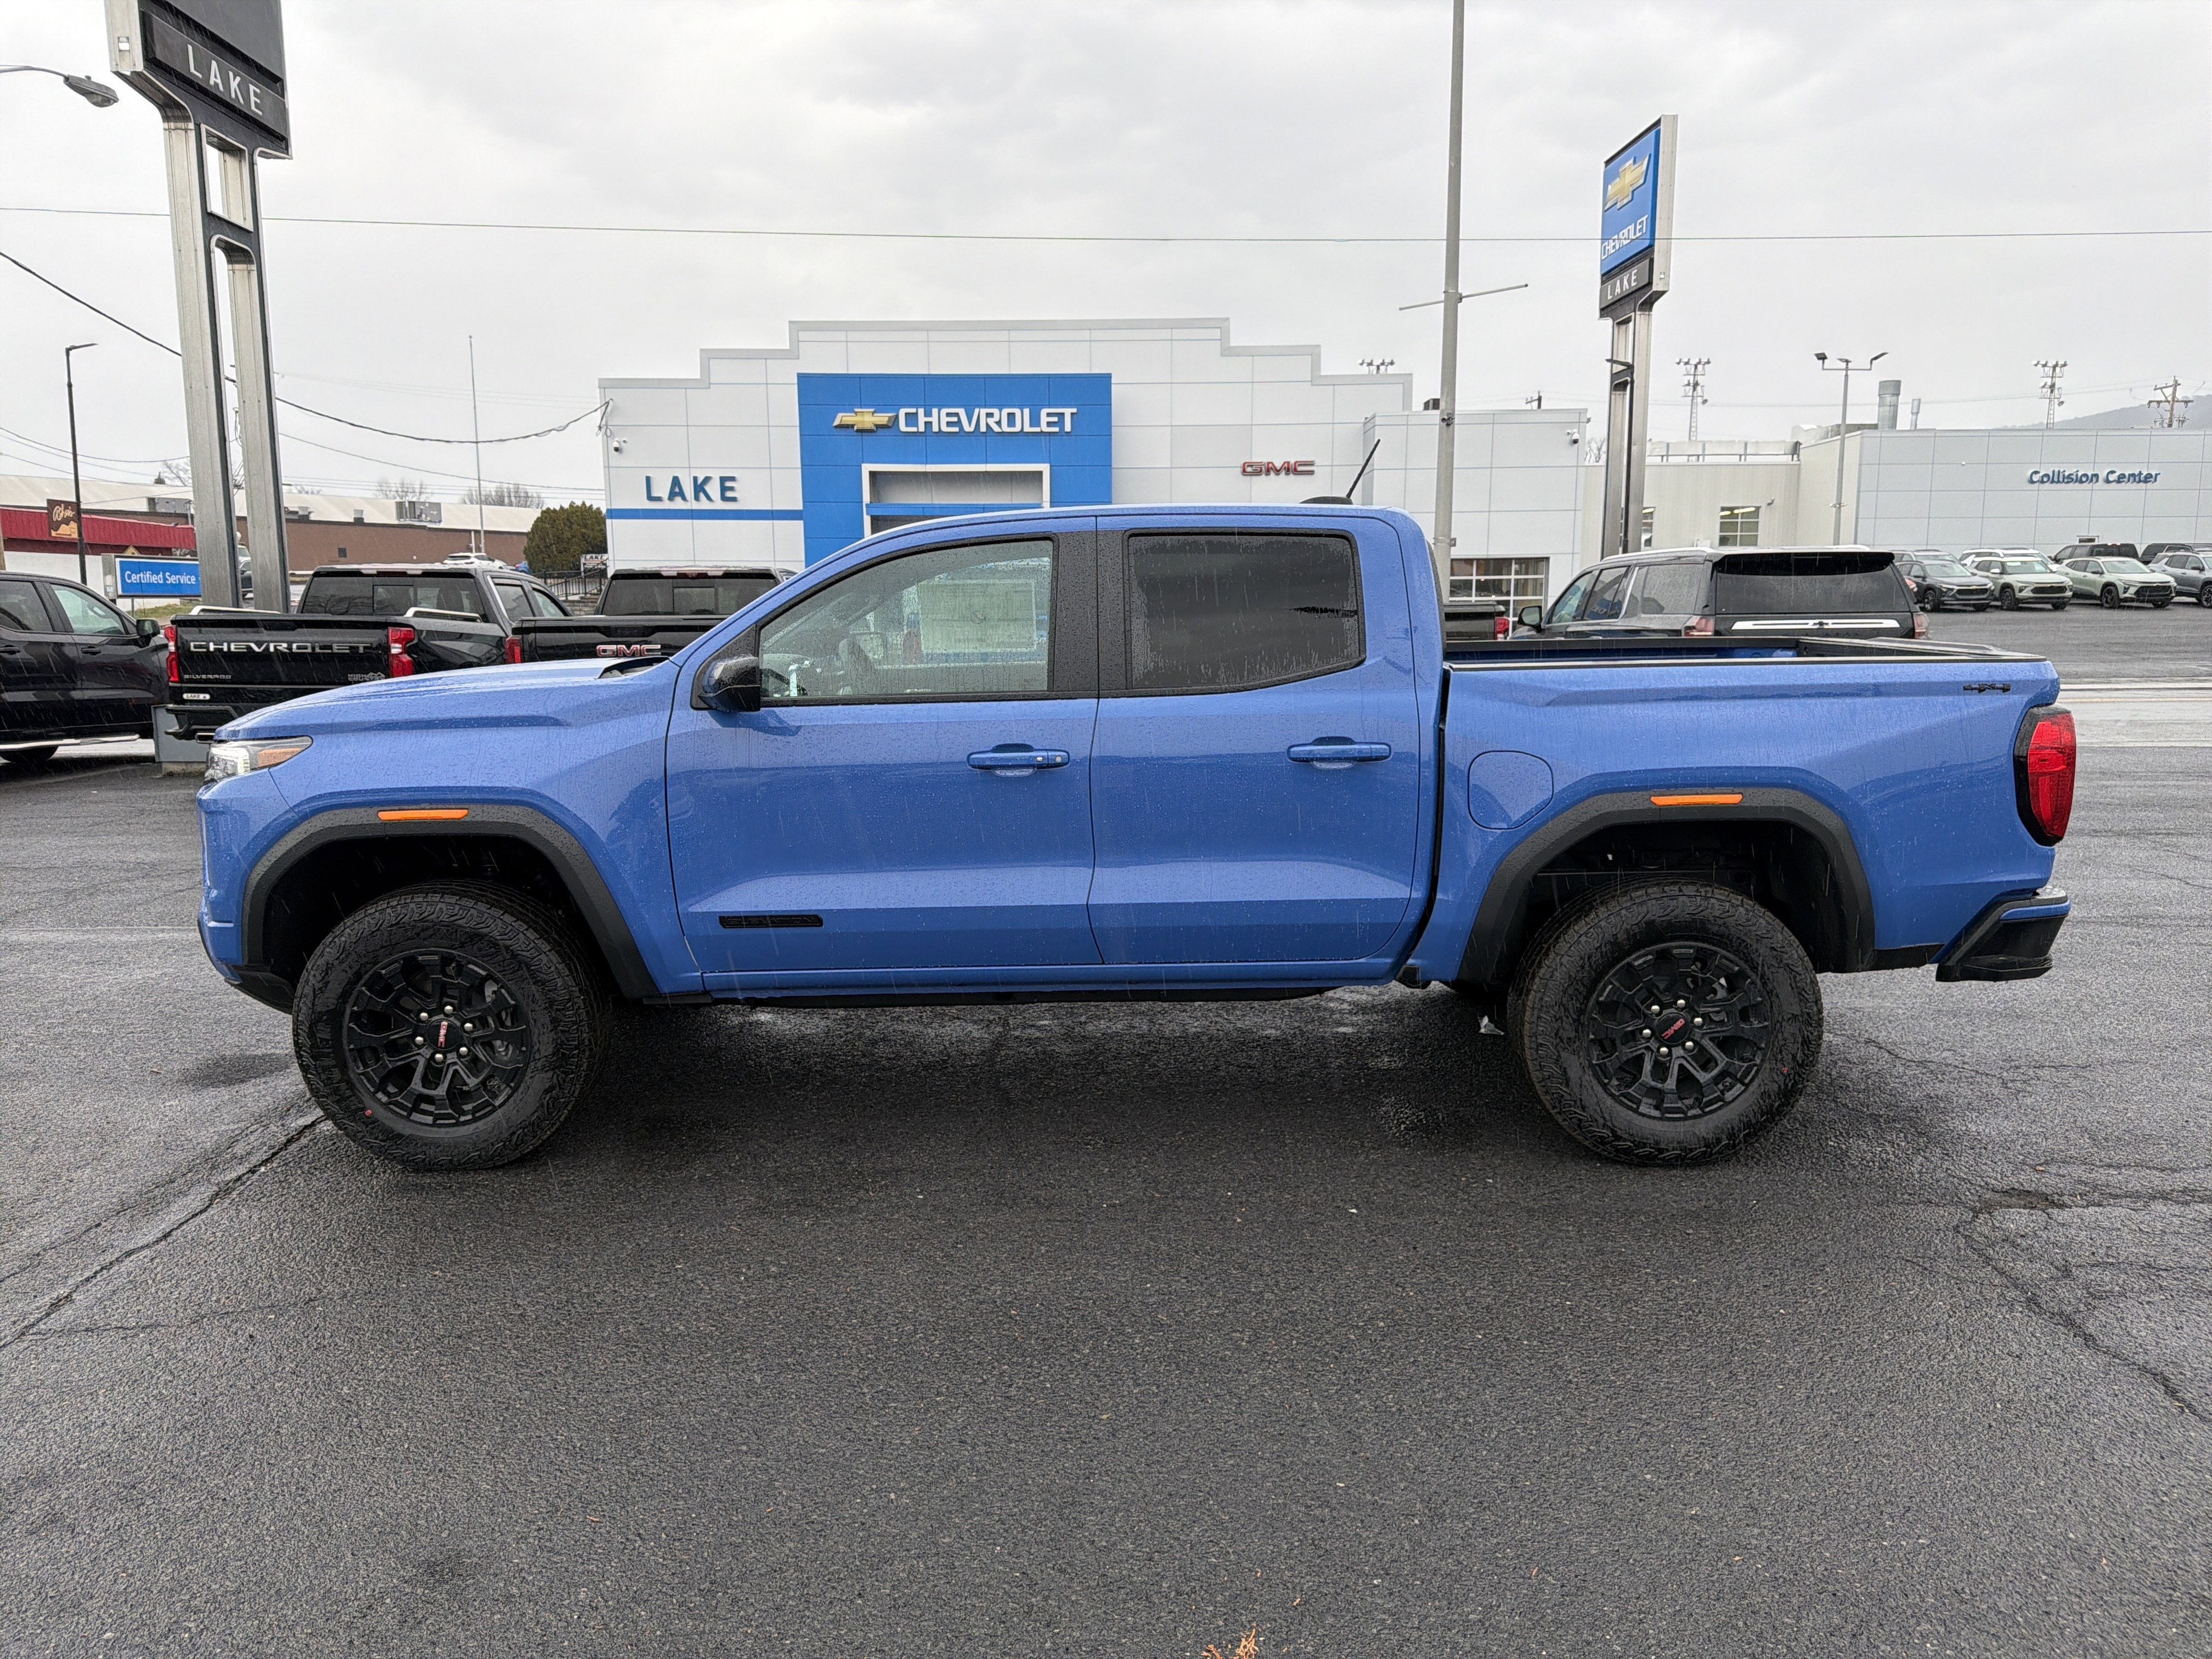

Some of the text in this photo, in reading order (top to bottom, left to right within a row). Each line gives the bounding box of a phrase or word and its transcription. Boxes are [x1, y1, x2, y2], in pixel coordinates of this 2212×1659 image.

[187, 43, 263, 116] LAKE
[1601, 215, 1649, 260] CHEVROLET
[1607, 269, 1638, 300] LAKE
[899, 408, 1077, 432] CHEVROLET
[1242, 460, 1316, 476] GMC
[2028, 470, 2160, 484] Collision Center
[645, 475, 738, 502] LAKE
[125, 571, 196, 584] Certified Service
[190, 642, 371, 653] CHEVROLET
[596, 645, 662, 657] GMC
